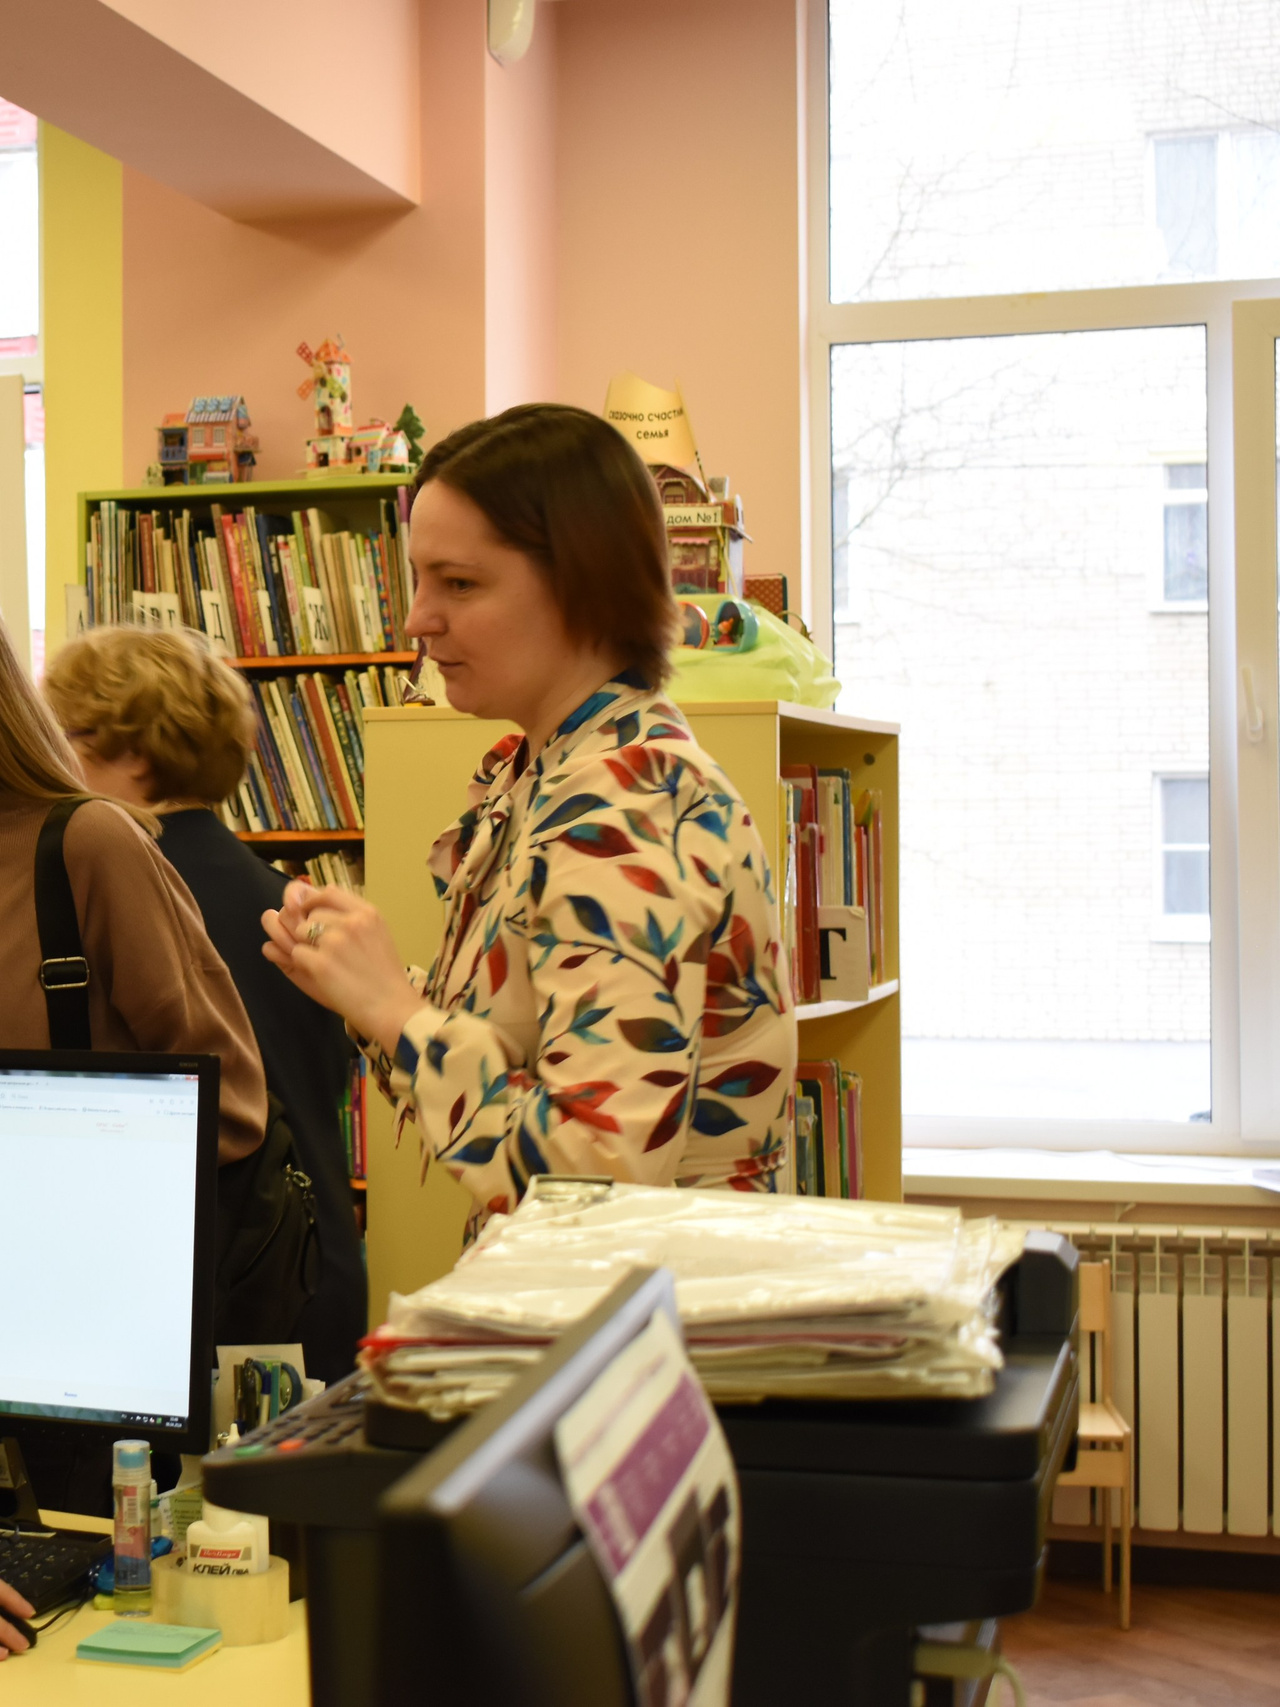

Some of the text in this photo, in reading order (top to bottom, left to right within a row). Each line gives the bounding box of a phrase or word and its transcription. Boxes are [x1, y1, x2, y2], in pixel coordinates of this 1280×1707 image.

[636, 429, 669, 439] семья
[666, 515, 692, 524] дом
[193, 1562, 231, 1576] КЛЕЙ
